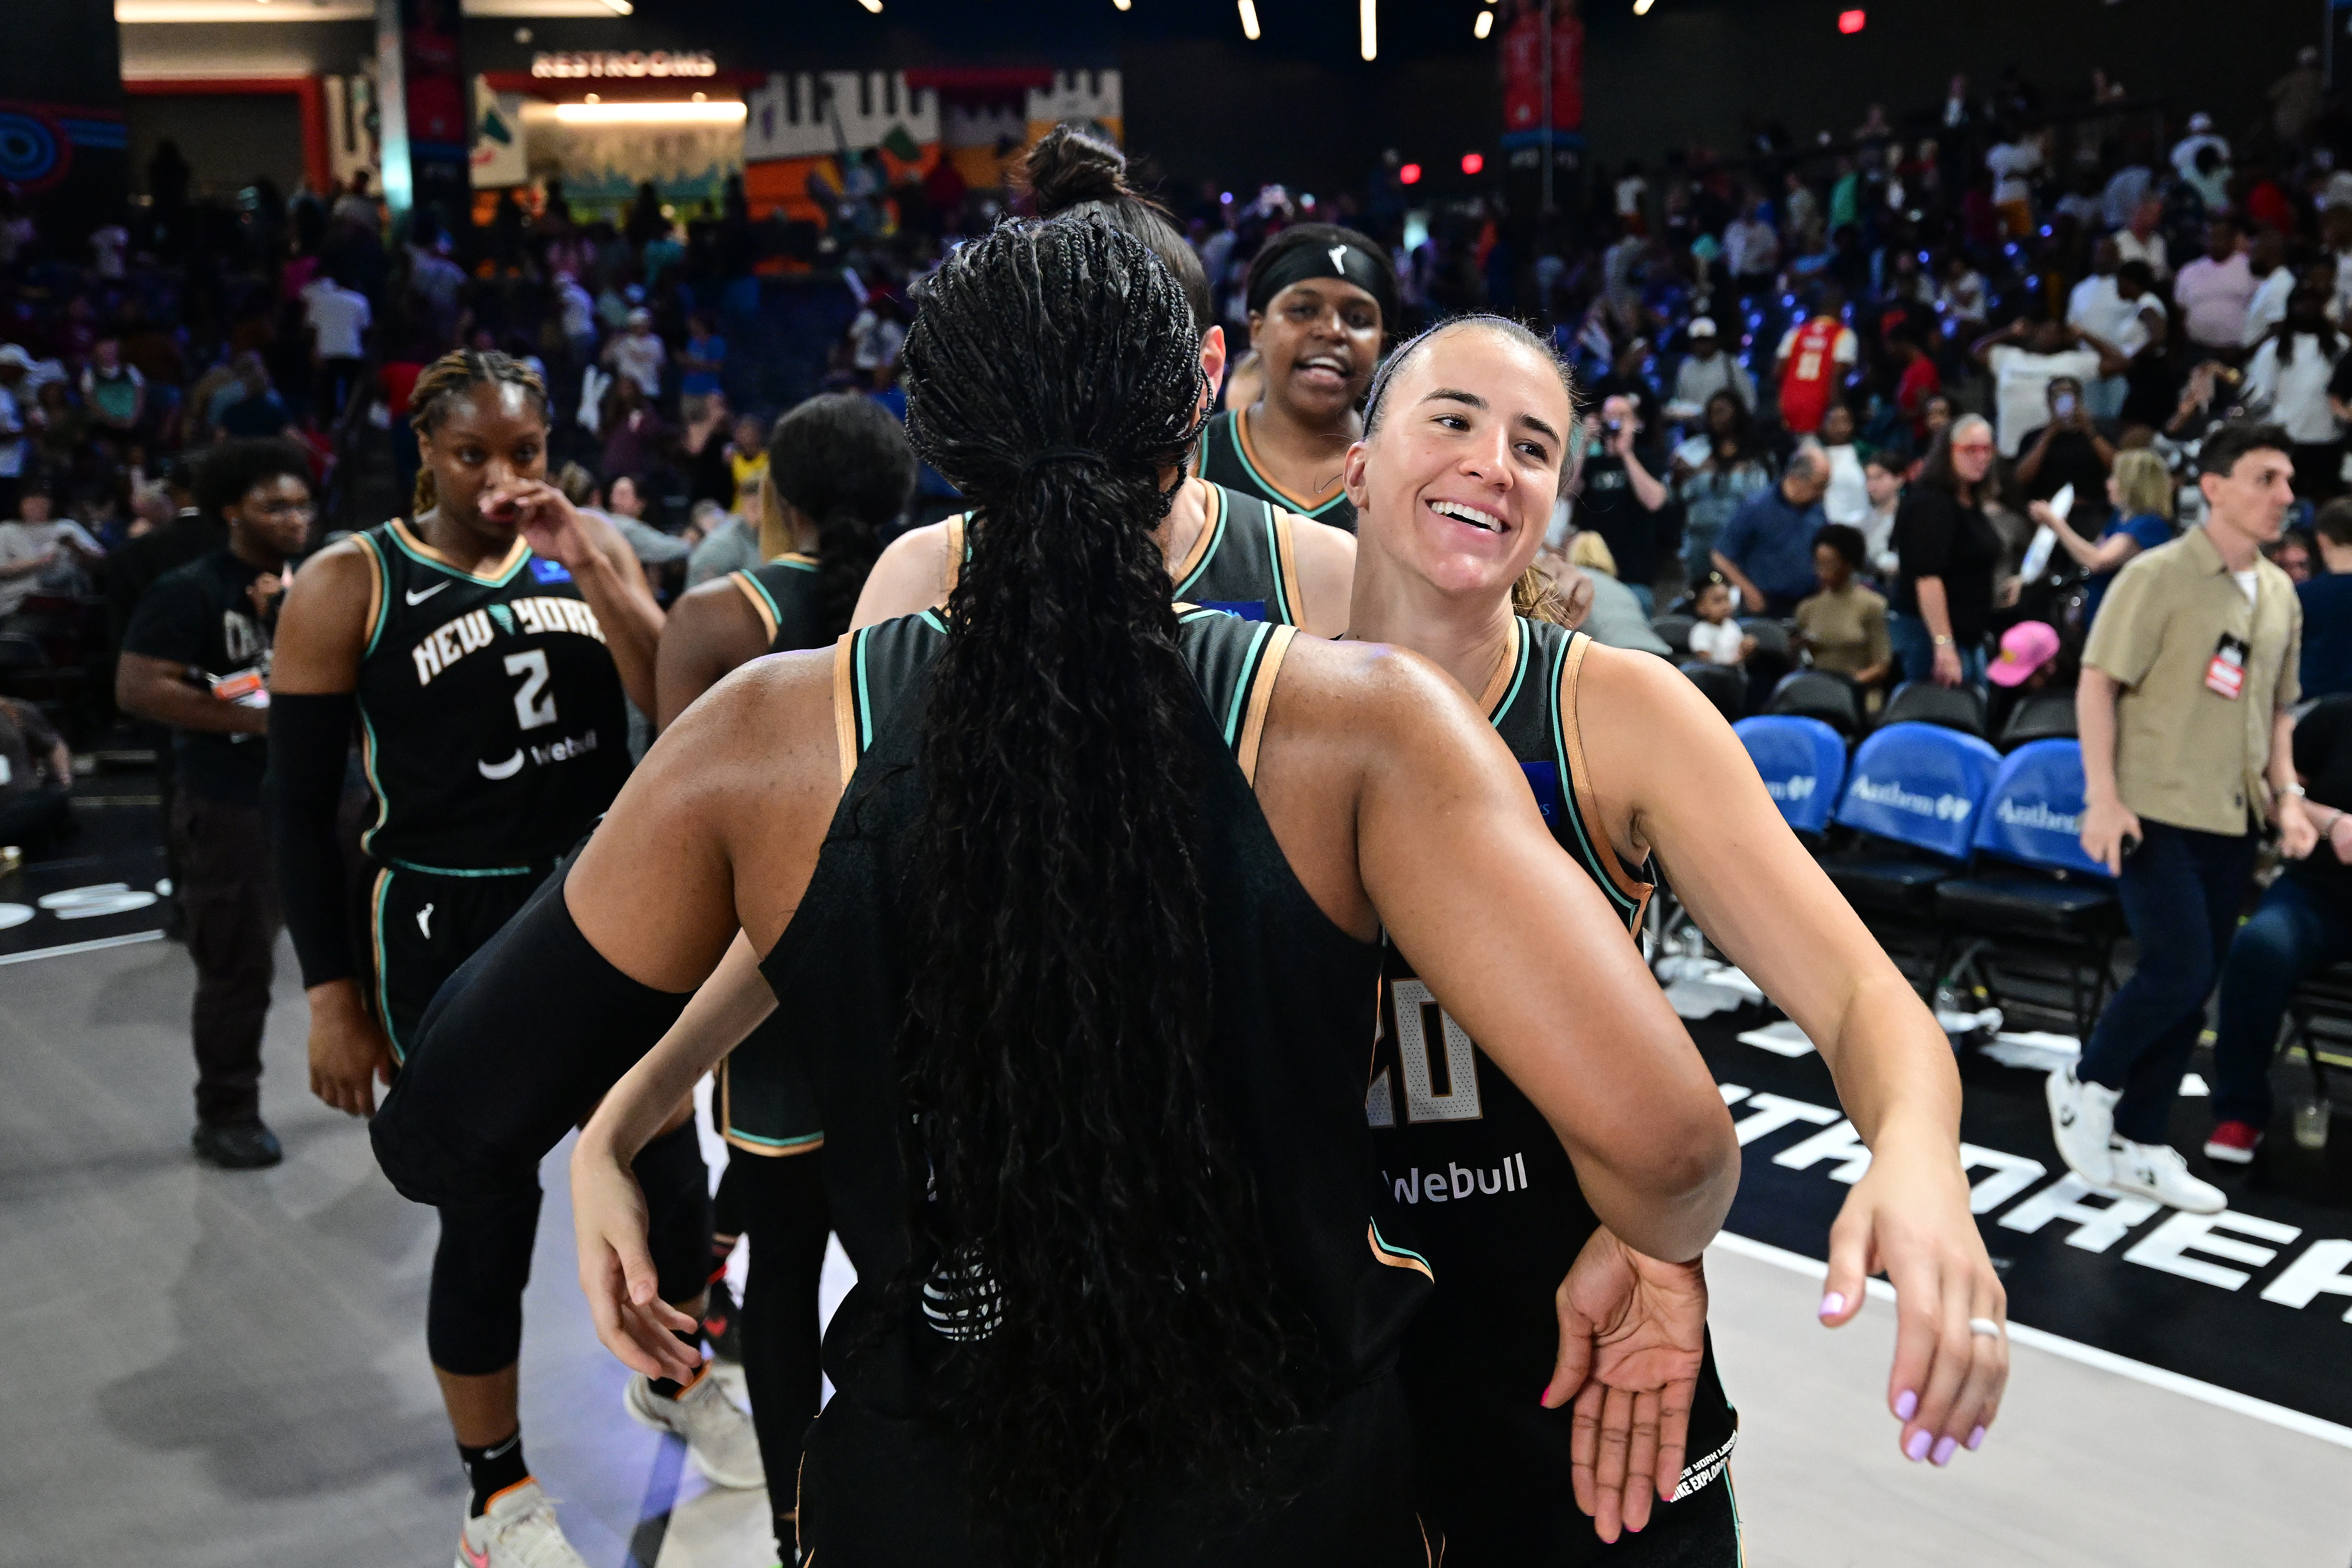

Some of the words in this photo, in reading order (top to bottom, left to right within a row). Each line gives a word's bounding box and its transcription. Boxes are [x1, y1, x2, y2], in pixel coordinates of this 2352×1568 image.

[412, 609, 496, 686] NEW
[510, 596, 607, 643] YORK
[503, 648, 558, 731] 2
[1382, 1152, 1528, 1204] Webull
[1692, 1452, 1718, 1471] YORK
